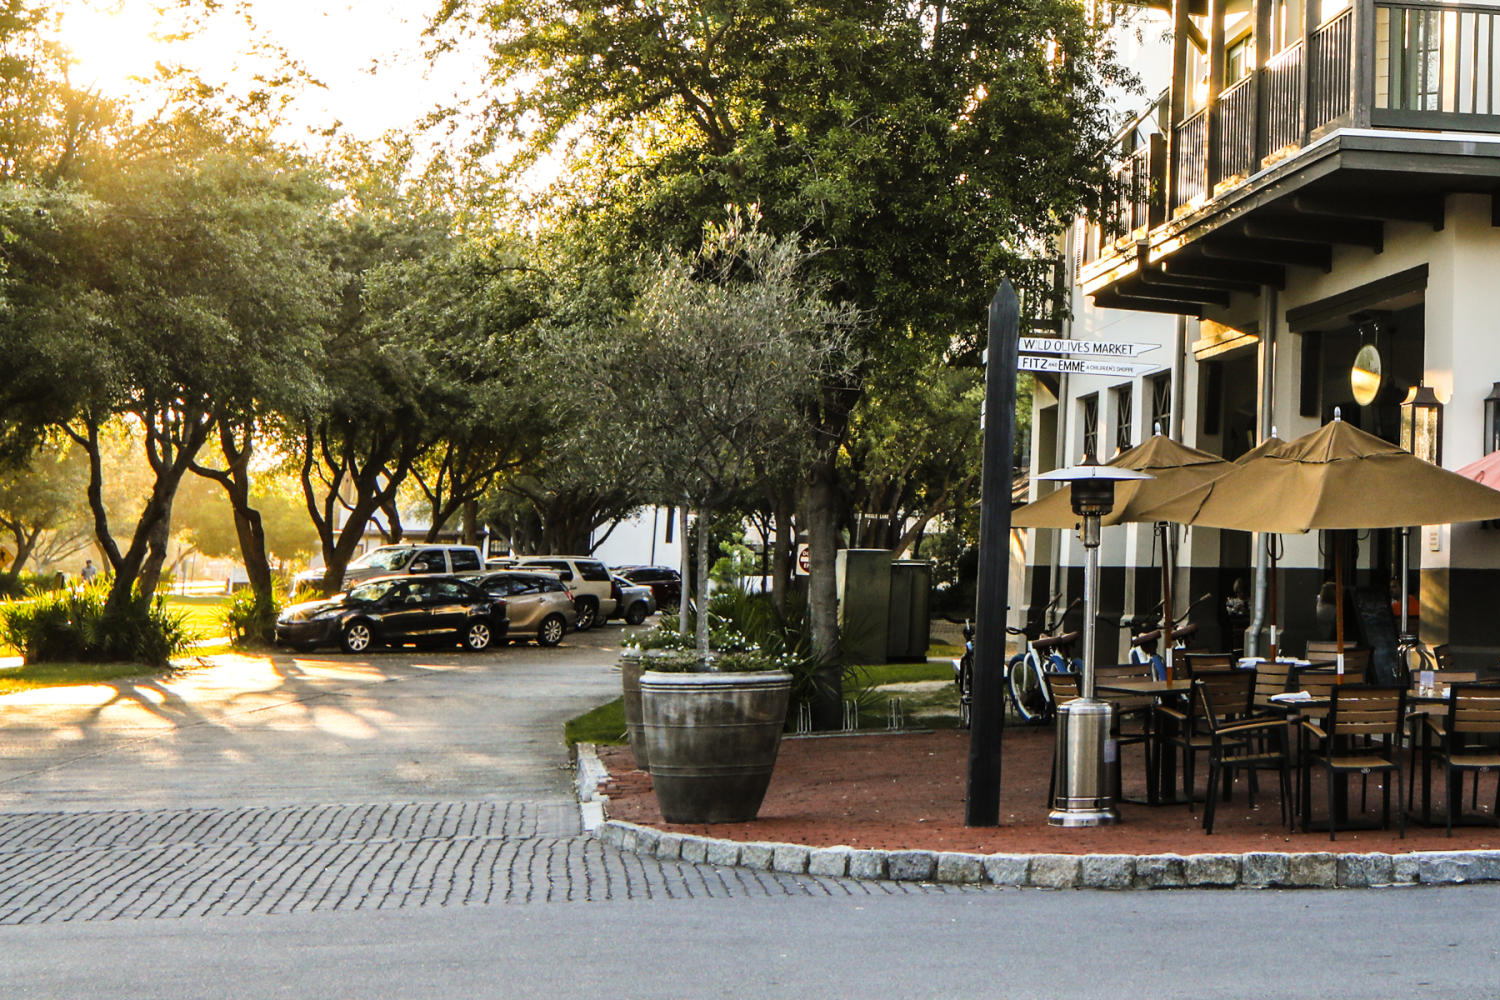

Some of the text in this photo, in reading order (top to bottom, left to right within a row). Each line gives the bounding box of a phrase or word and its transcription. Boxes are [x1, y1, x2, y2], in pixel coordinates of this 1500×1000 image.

[1054, 340, 1090, 353] OLIVES
[1093, 343, 1134, 355] MARKET
[1022, 357, 1048, 370] FITZ
[1058, 360, 1086, 372] EMME
